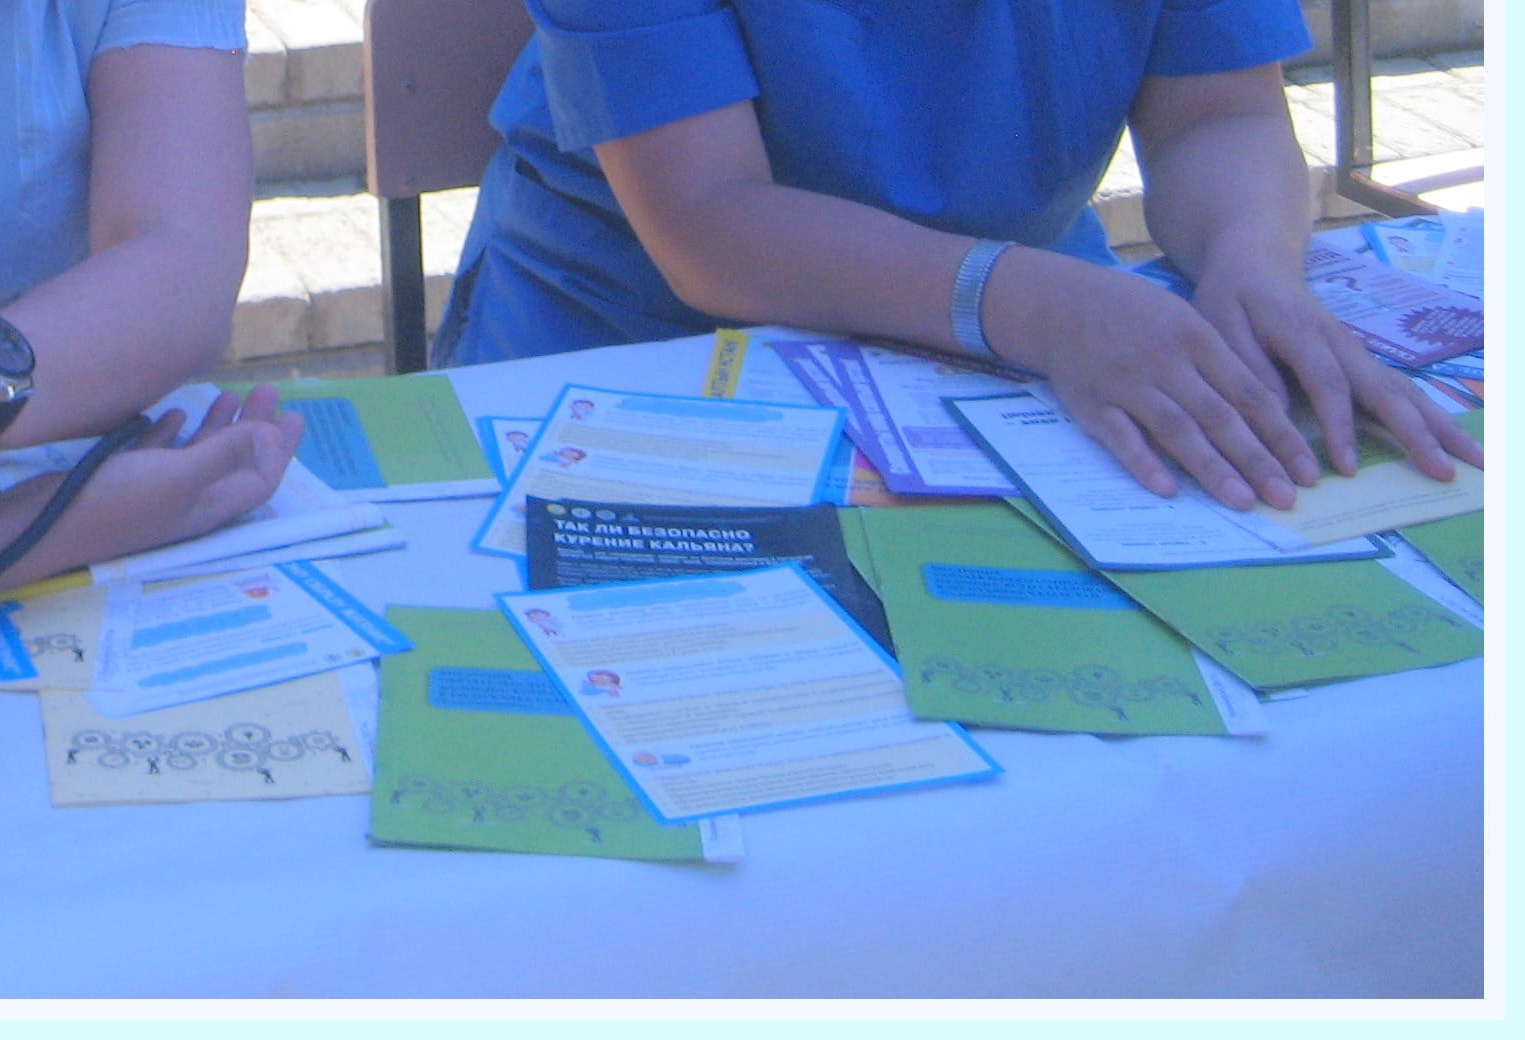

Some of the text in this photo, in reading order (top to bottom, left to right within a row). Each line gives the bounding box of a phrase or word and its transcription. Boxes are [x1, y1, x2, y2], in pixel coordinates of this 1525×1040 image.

[554, 518, 751, 540] ТАК ЛИ БЕЗОПАСНО
[553, 532, 756, 553] КУРЕНИЕ КАЛЬЯНА?
